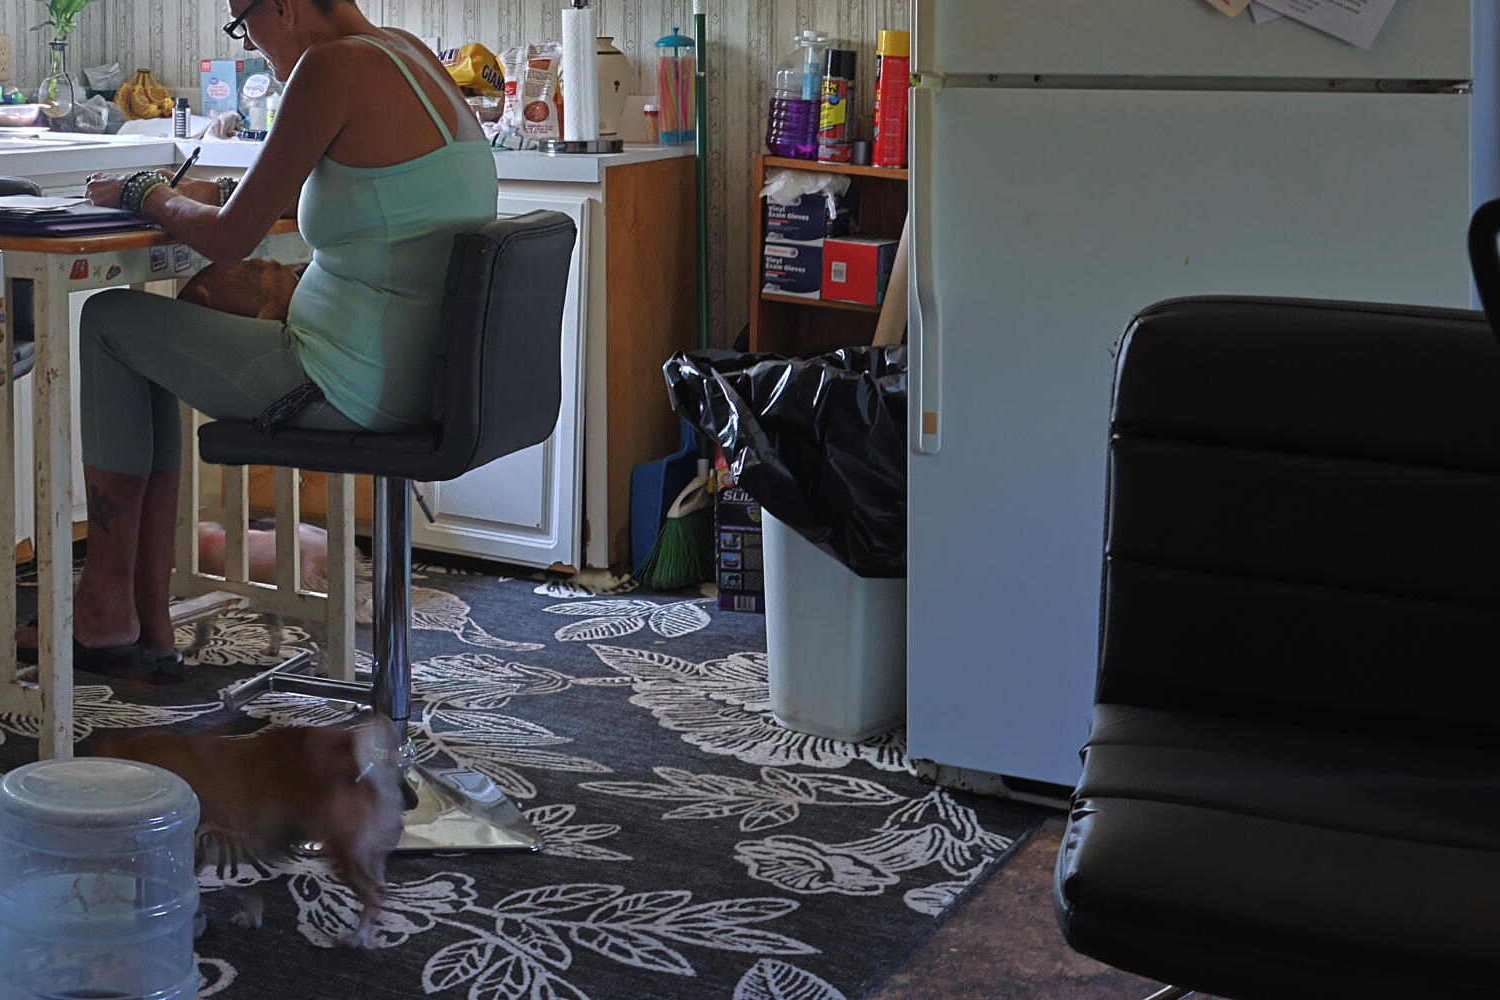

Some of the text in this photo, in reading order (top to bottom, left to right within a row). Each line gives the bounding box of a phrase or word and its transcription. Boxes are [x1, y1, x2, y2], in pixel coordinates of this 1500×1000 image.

[482, 64, 505, 92] GIAN
[767, 205, 786, 214] Vinyl
[767, 211, 810, 222] Exam Gloves
[765, 256, 783, 265] Vinyl
[765, 263, 806, 274] Exam Gloves
[723, 490, 755, 502] SLID
